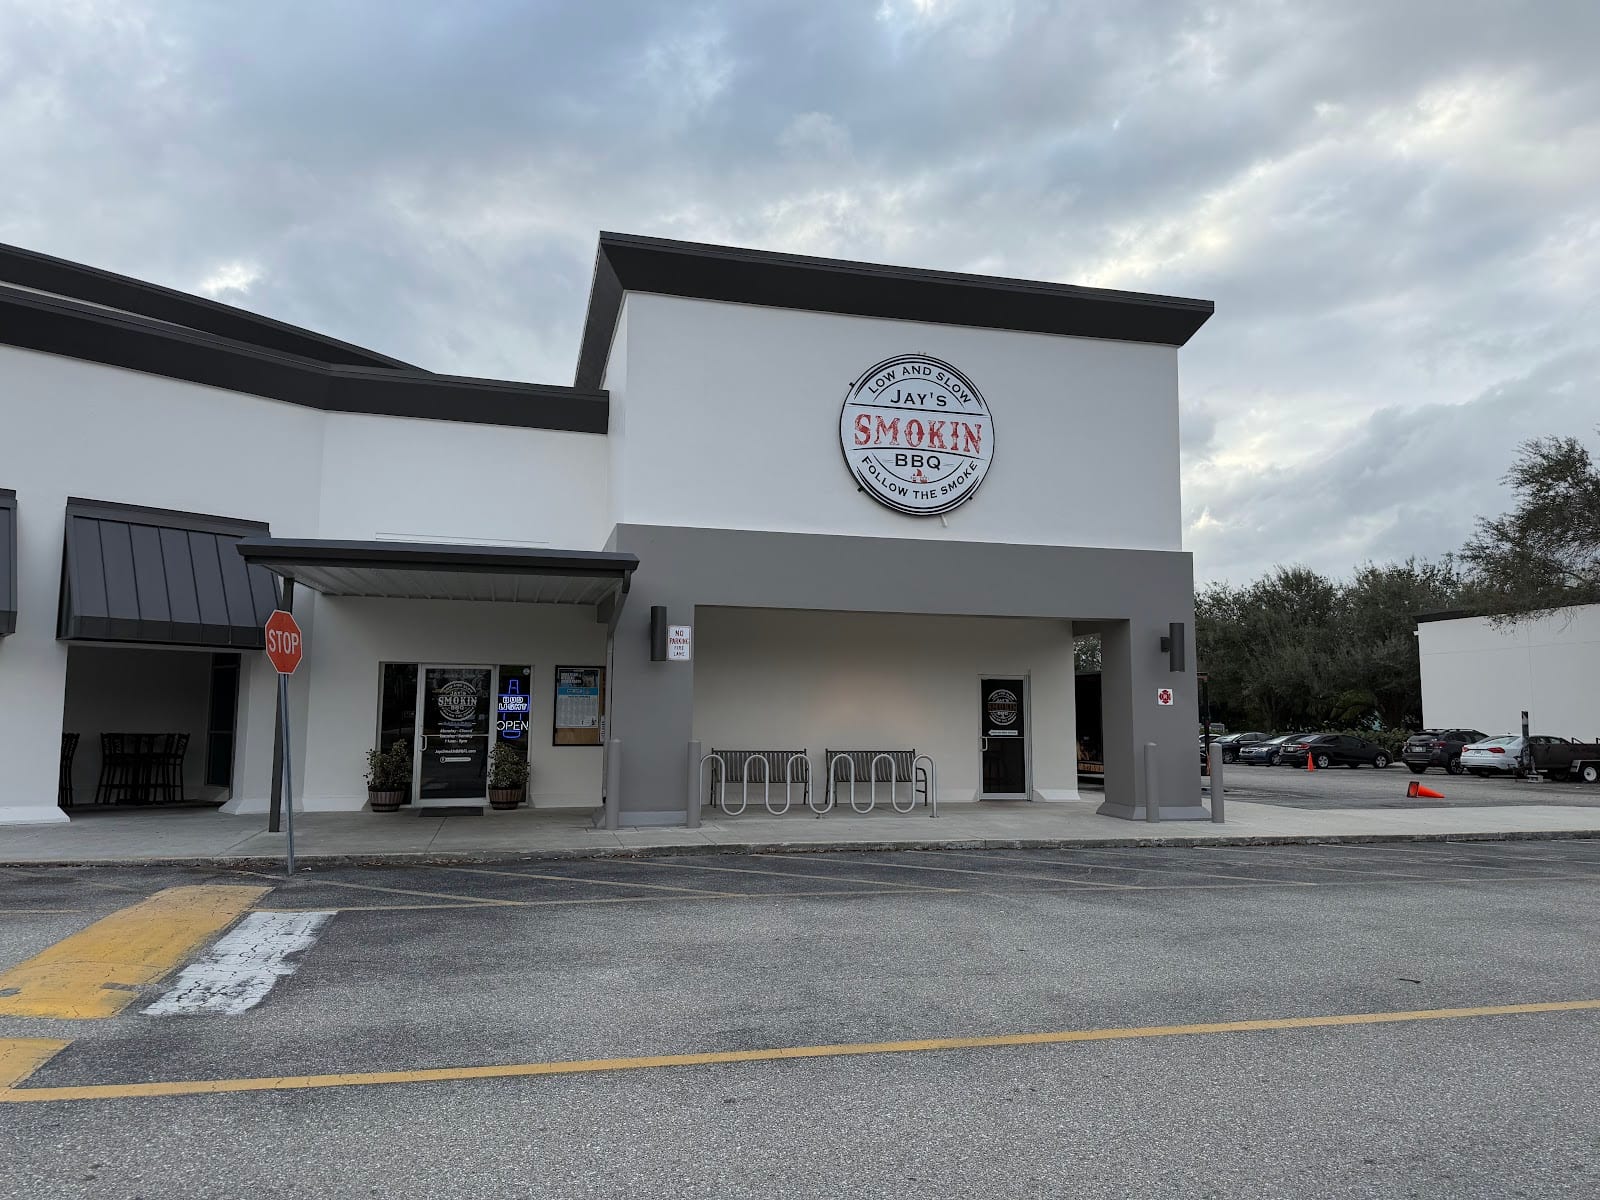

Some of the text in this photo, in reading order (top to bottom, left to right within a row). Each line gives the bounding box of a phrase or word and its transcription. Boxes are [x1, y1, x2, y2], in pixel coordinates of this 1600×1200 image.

[868, 365, 971, 403] LOW AND SLOW
[890, 389, 947, 407] JAY'S
[854, 413, 982, 454] SMOKIN
[895, 453, 941, 470] BBQ
[861, 456, 978, 500] FOLLOW THE SMOKE
[268, 628, 299, 655] STOP
[438, 696, 478, 706] SMOKIN
[502, 696, 523, 704] BUD
[496, 720, 529, 731] OPEN
